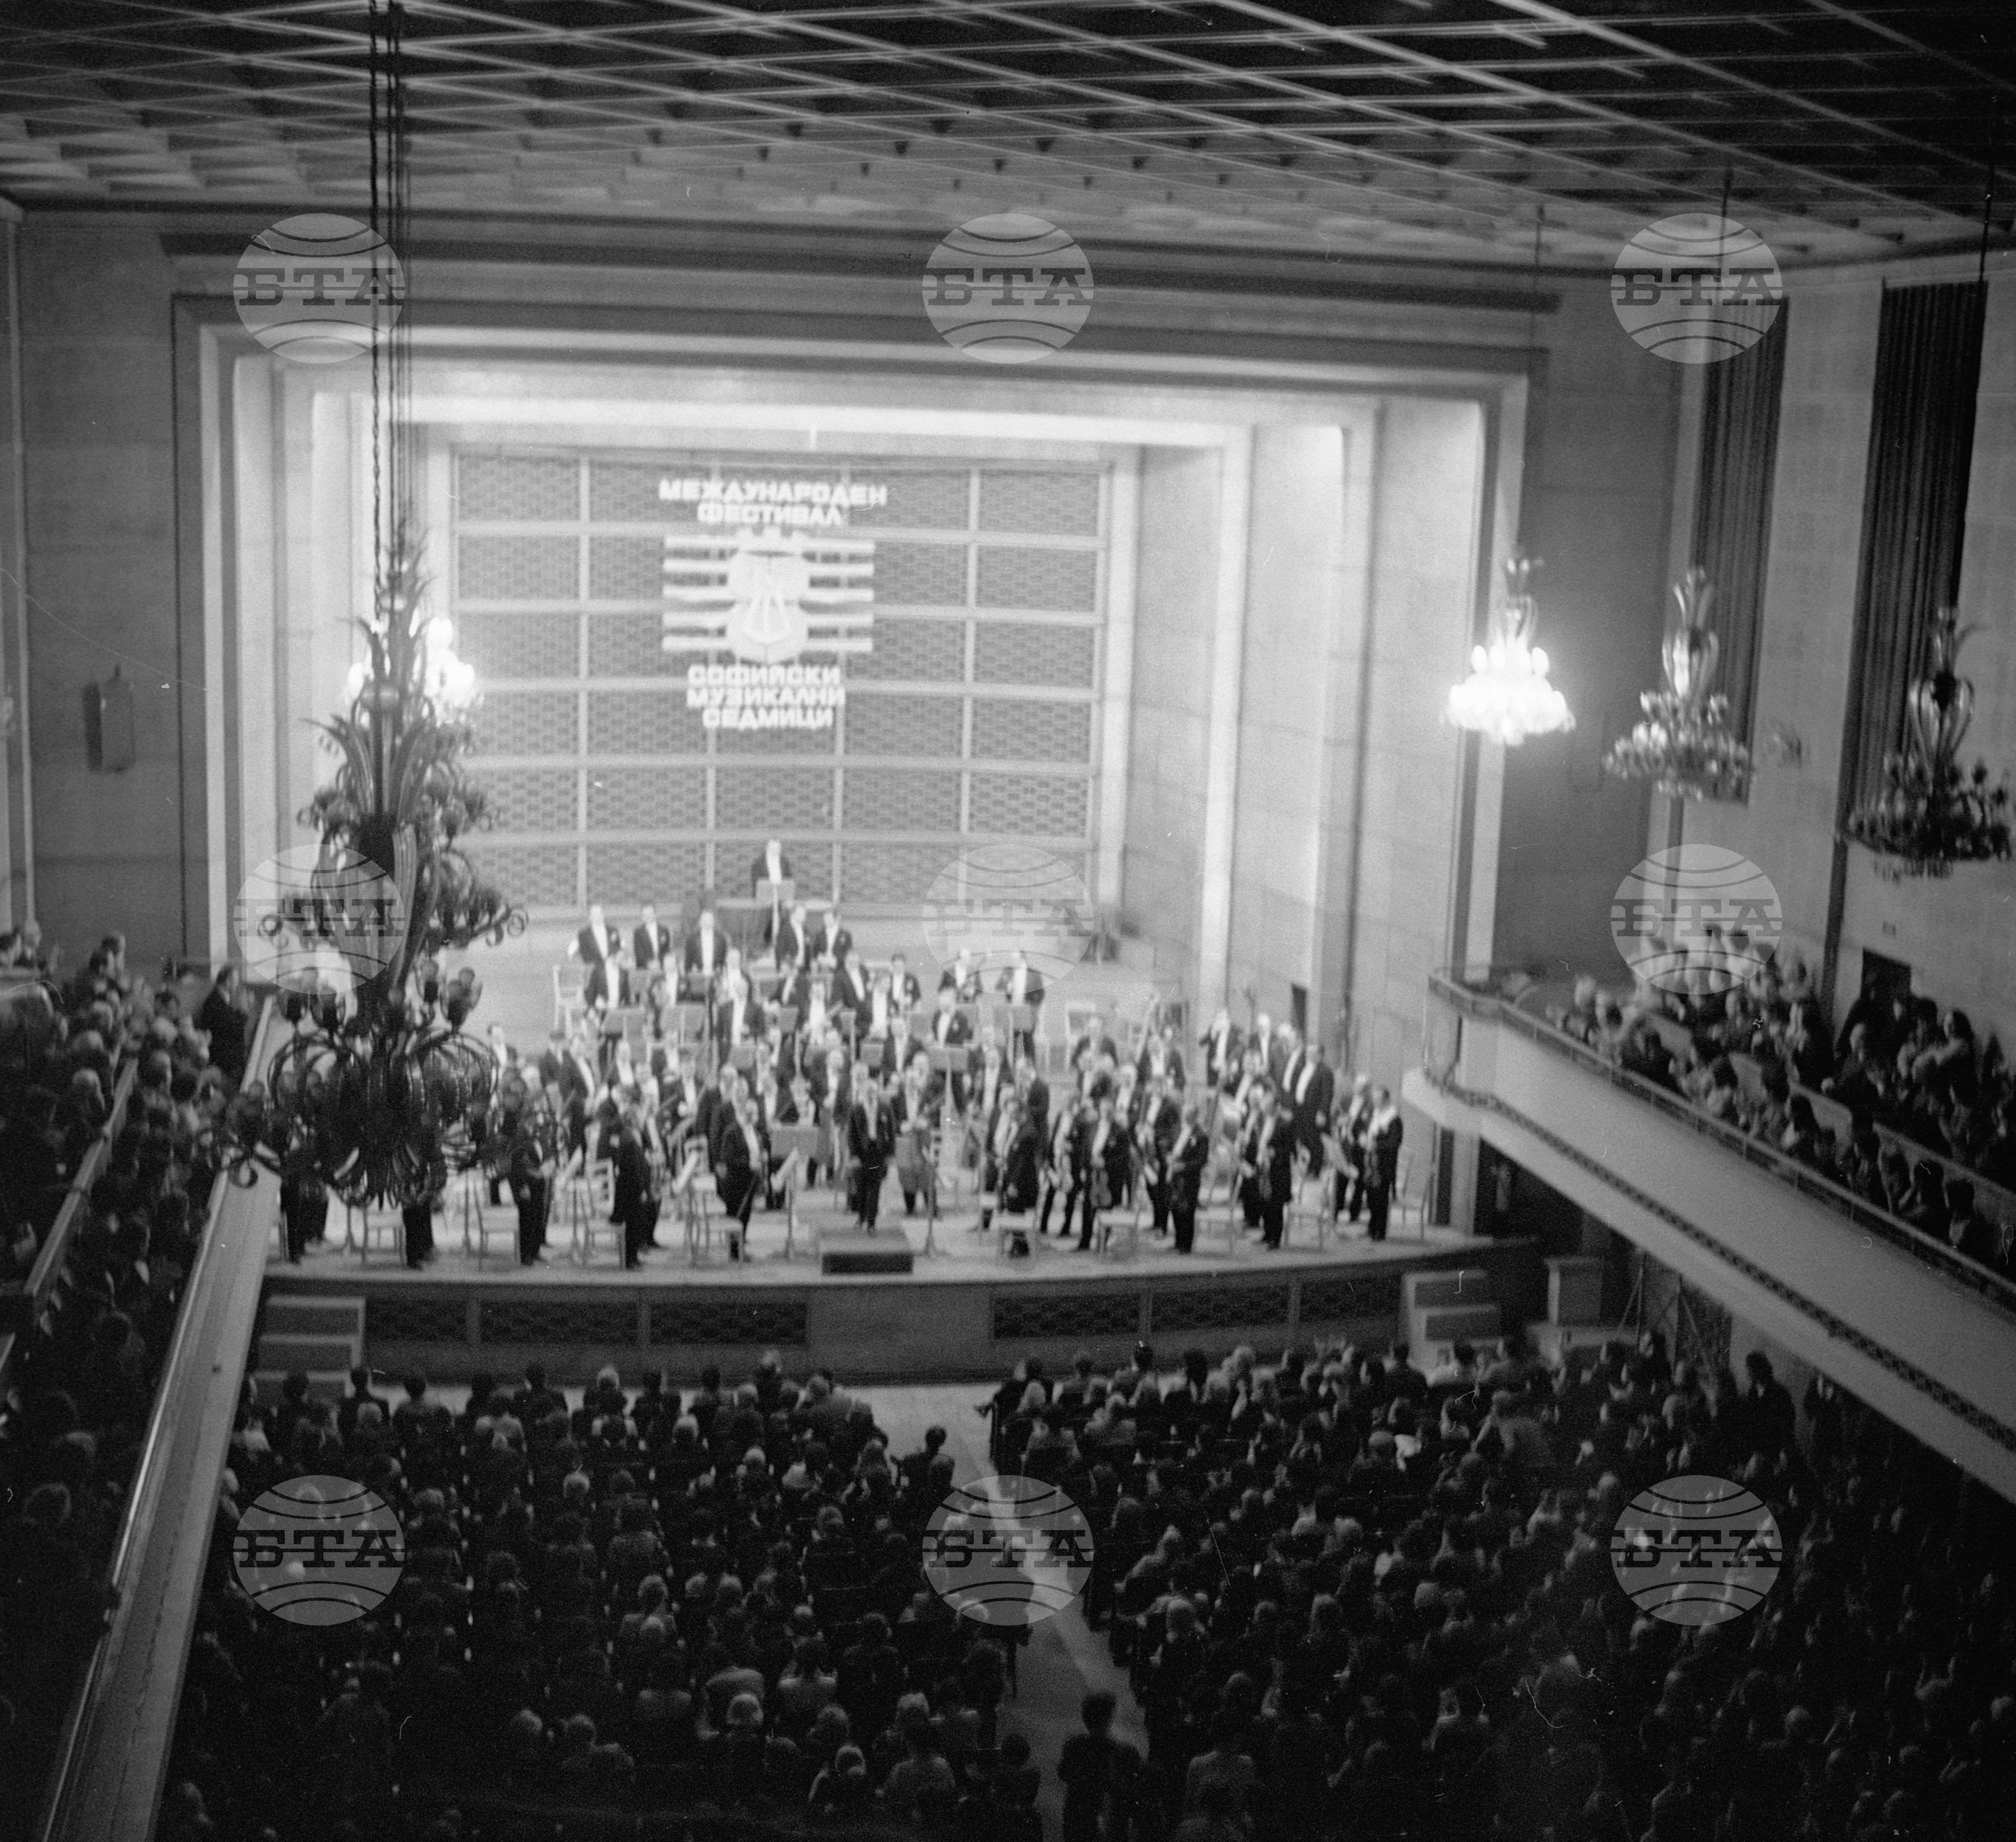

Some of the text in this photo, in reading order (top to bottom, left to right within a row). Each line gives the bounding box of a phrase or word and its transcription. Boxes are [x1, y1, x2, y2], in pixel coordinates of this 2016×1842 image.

[659, 478, 887, 506] МЕЖДУНАРОДЕН
[697, 504, 843, 526] ФЕСТИВАЛ
[686, 686, 846, 708] МУЗИКАЛНИ
